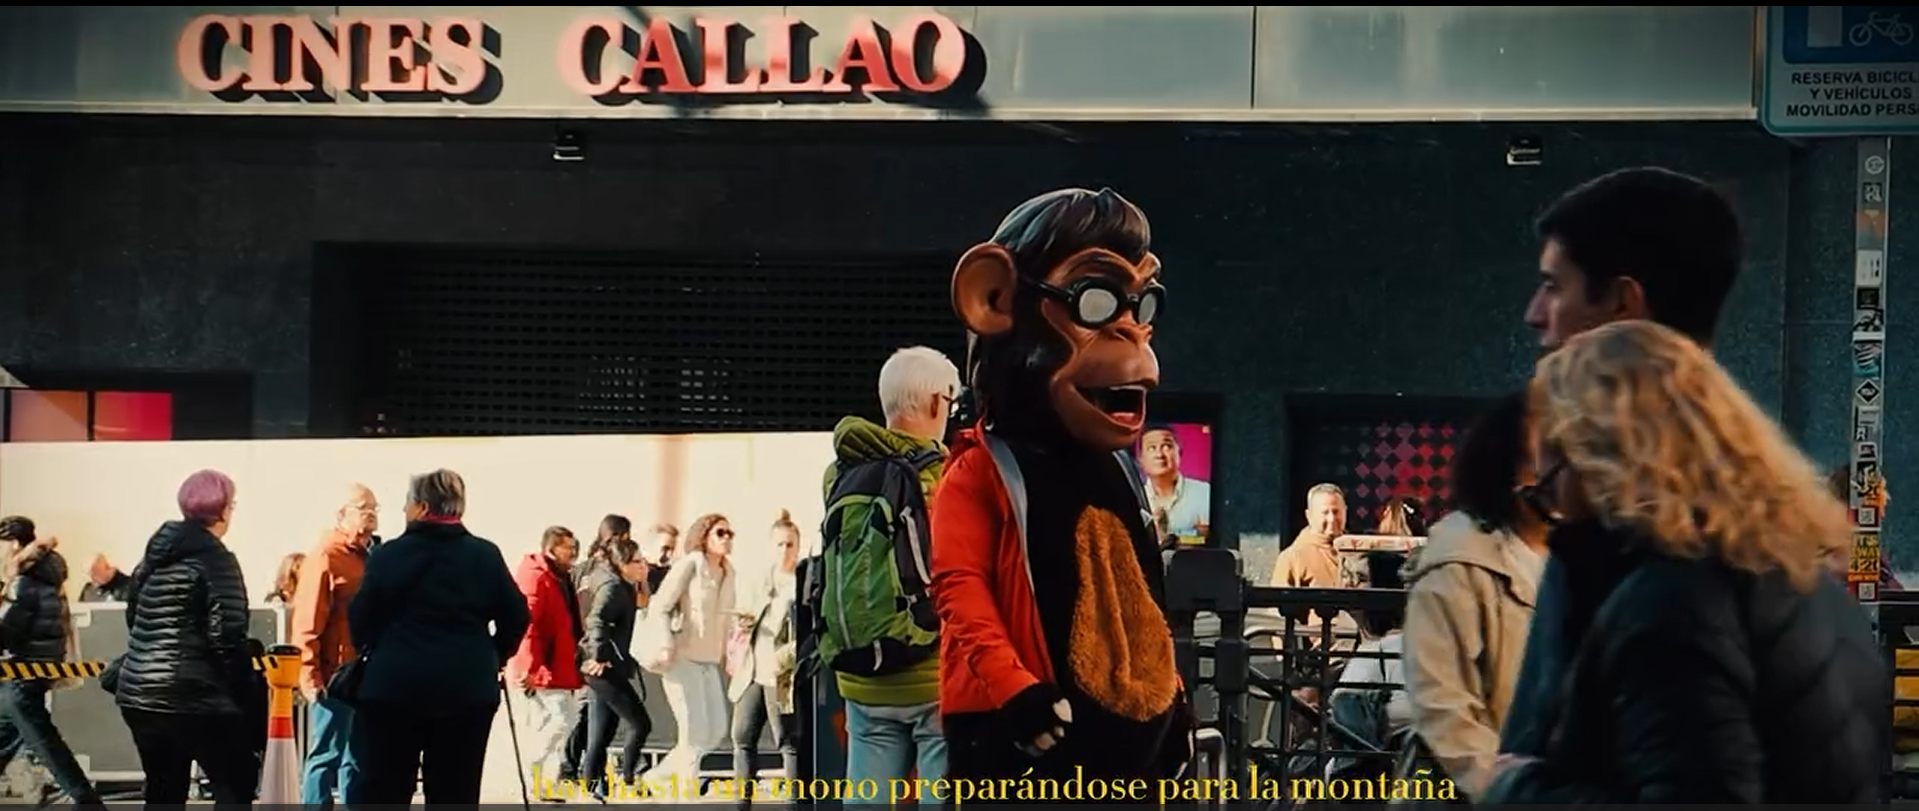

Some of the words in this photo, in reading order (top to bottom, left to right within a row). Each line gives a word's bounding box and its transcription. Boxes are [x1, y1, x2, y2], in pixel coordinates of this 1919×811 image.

[174, 13, 490, 97] CINES
[556, 11, 972, 96] CALLAO
[1791, 71, 1863, 85] RESERVA
[1867, 71, 1919, 84] BICICL
[1810, 88, 1820, 99] Y
[1824, 86, 1912, 100] VEHÍCULOS
[1786, 104, 1871, 116] MOVILIDAD
[1876, 103, 1919, 116] PERS
